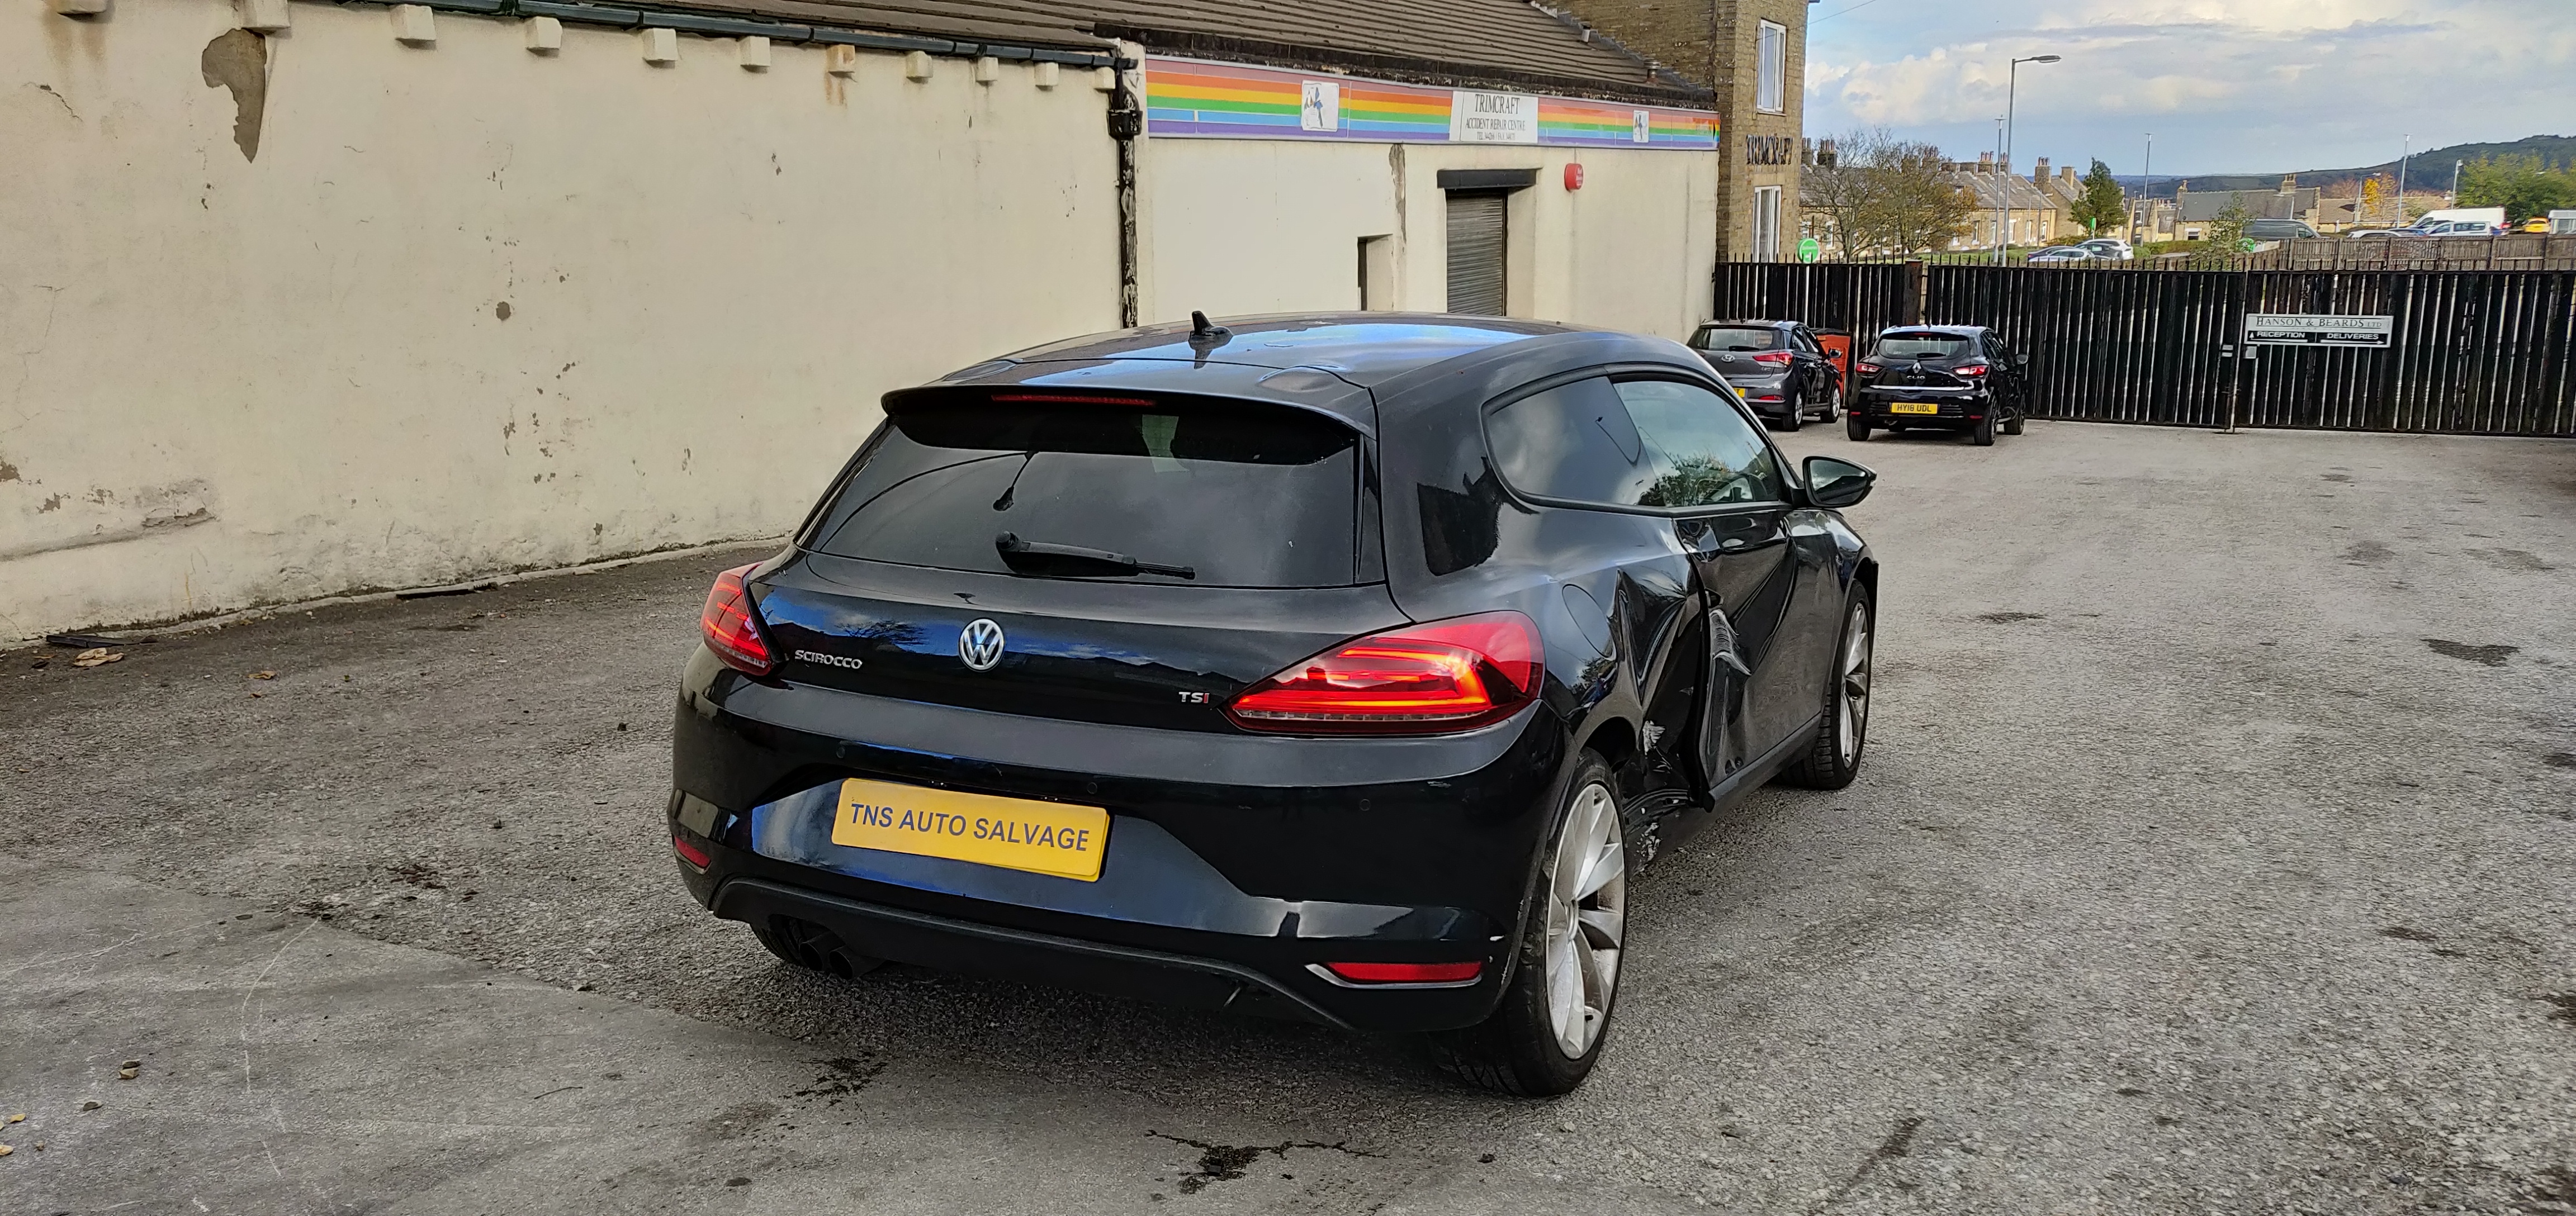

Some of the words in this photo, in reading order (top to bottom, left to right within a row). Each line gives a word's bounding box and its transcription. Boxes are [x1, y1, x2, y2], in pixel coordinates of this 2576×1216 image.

[1475, 94, 1520, 115] TRIMCRAFT
[1465, 117, 1489, 129] ACCIDENT
[1490, 118, 1507, 130] REPAIR
[1508, 120, 1526, 131] CENTRE
[2256, 317, 2302, 326] HANSON
[2319, 319, 2364, 327] BEARDS
[958, 618, 1005, 672] VW
[794, 649, 863, 670] SCIROCCO
[1178, 691, 1210, 704] TSI
[851, 803, 893, 828] TNS
[898, 809, 966, 837] AUTO
[973, 818, 1090, 851] SALVAGE
